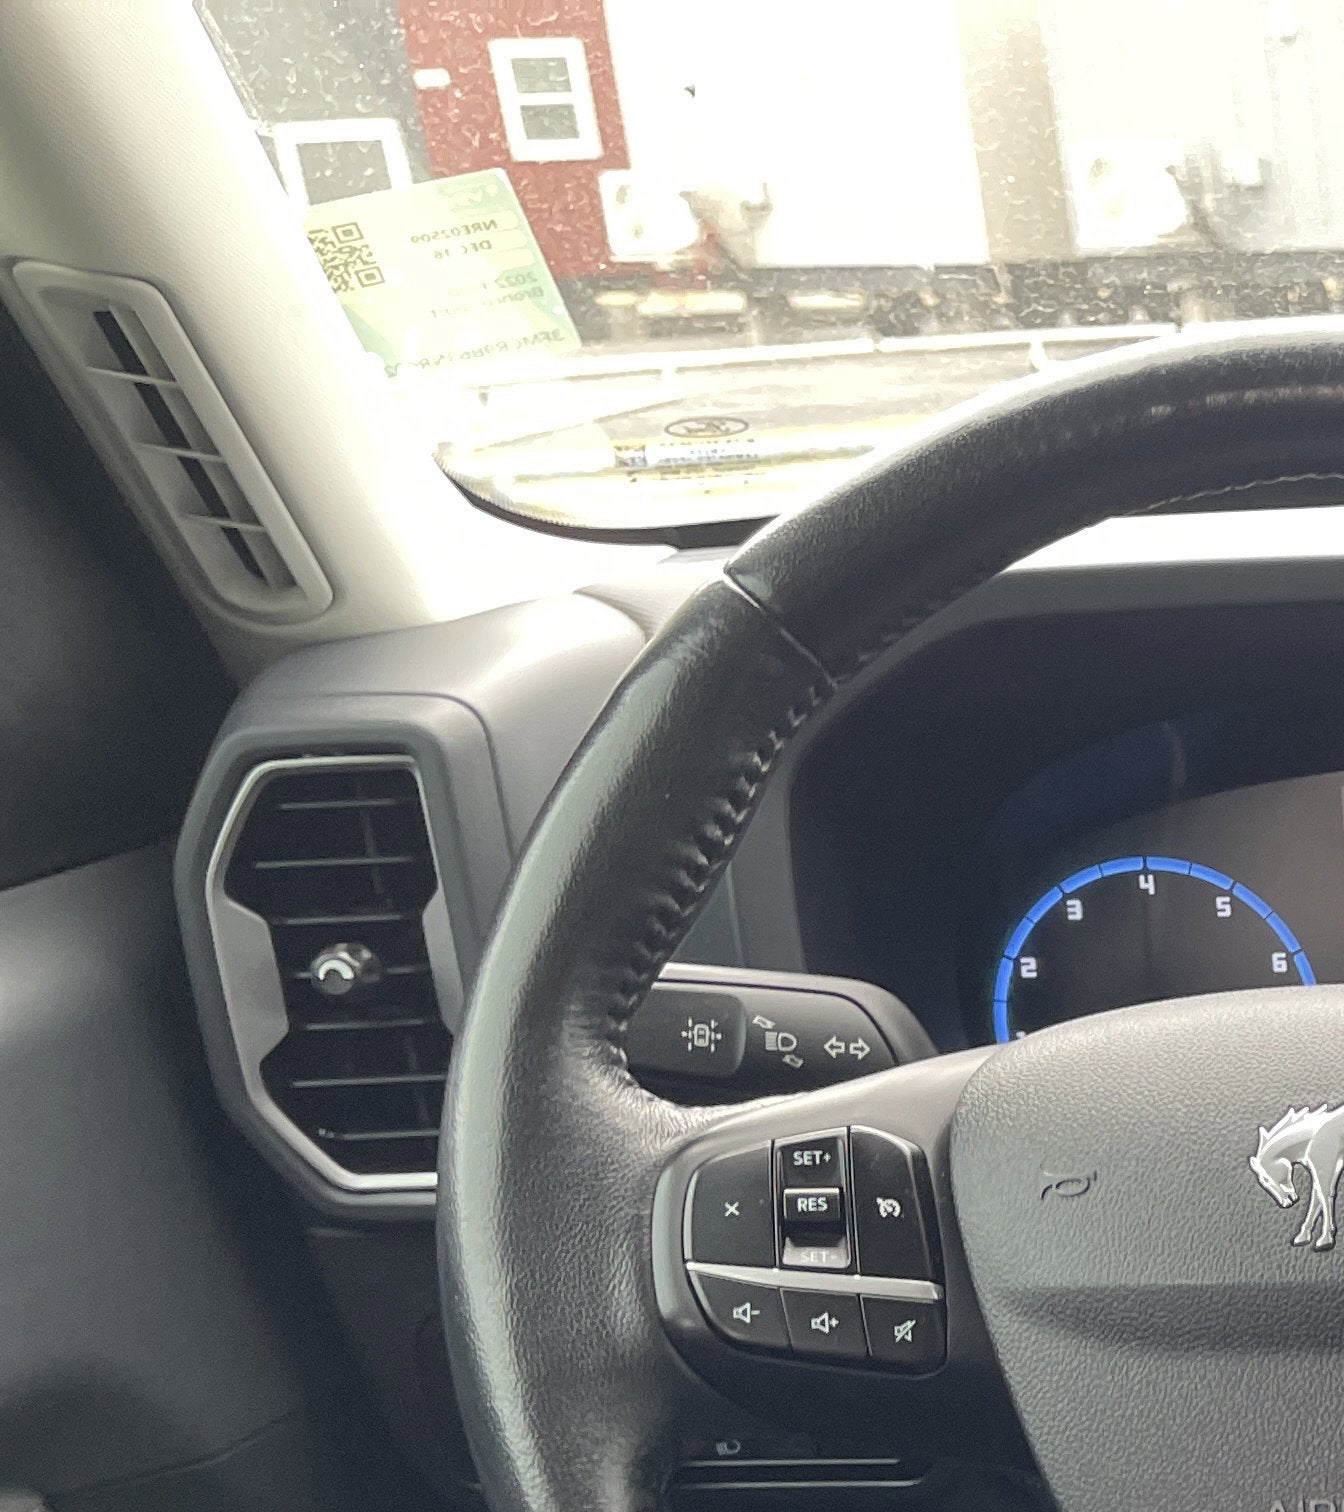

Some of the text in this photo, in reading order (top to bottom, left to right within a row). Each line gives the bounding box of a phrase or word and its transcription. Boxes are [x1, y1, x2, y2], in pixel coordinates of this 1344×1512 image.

[1139, 874, 1156, 896] 4
[1066, 899, 1083, 921] 3
[1215, 897, 1232, 918] 5
[1020, 957, 1037, 978] 2
[1272, 952, 1288, 973] 6
[793, 1150, 832, 1167] SET+
[797, 1197, 828, 1213] RES
